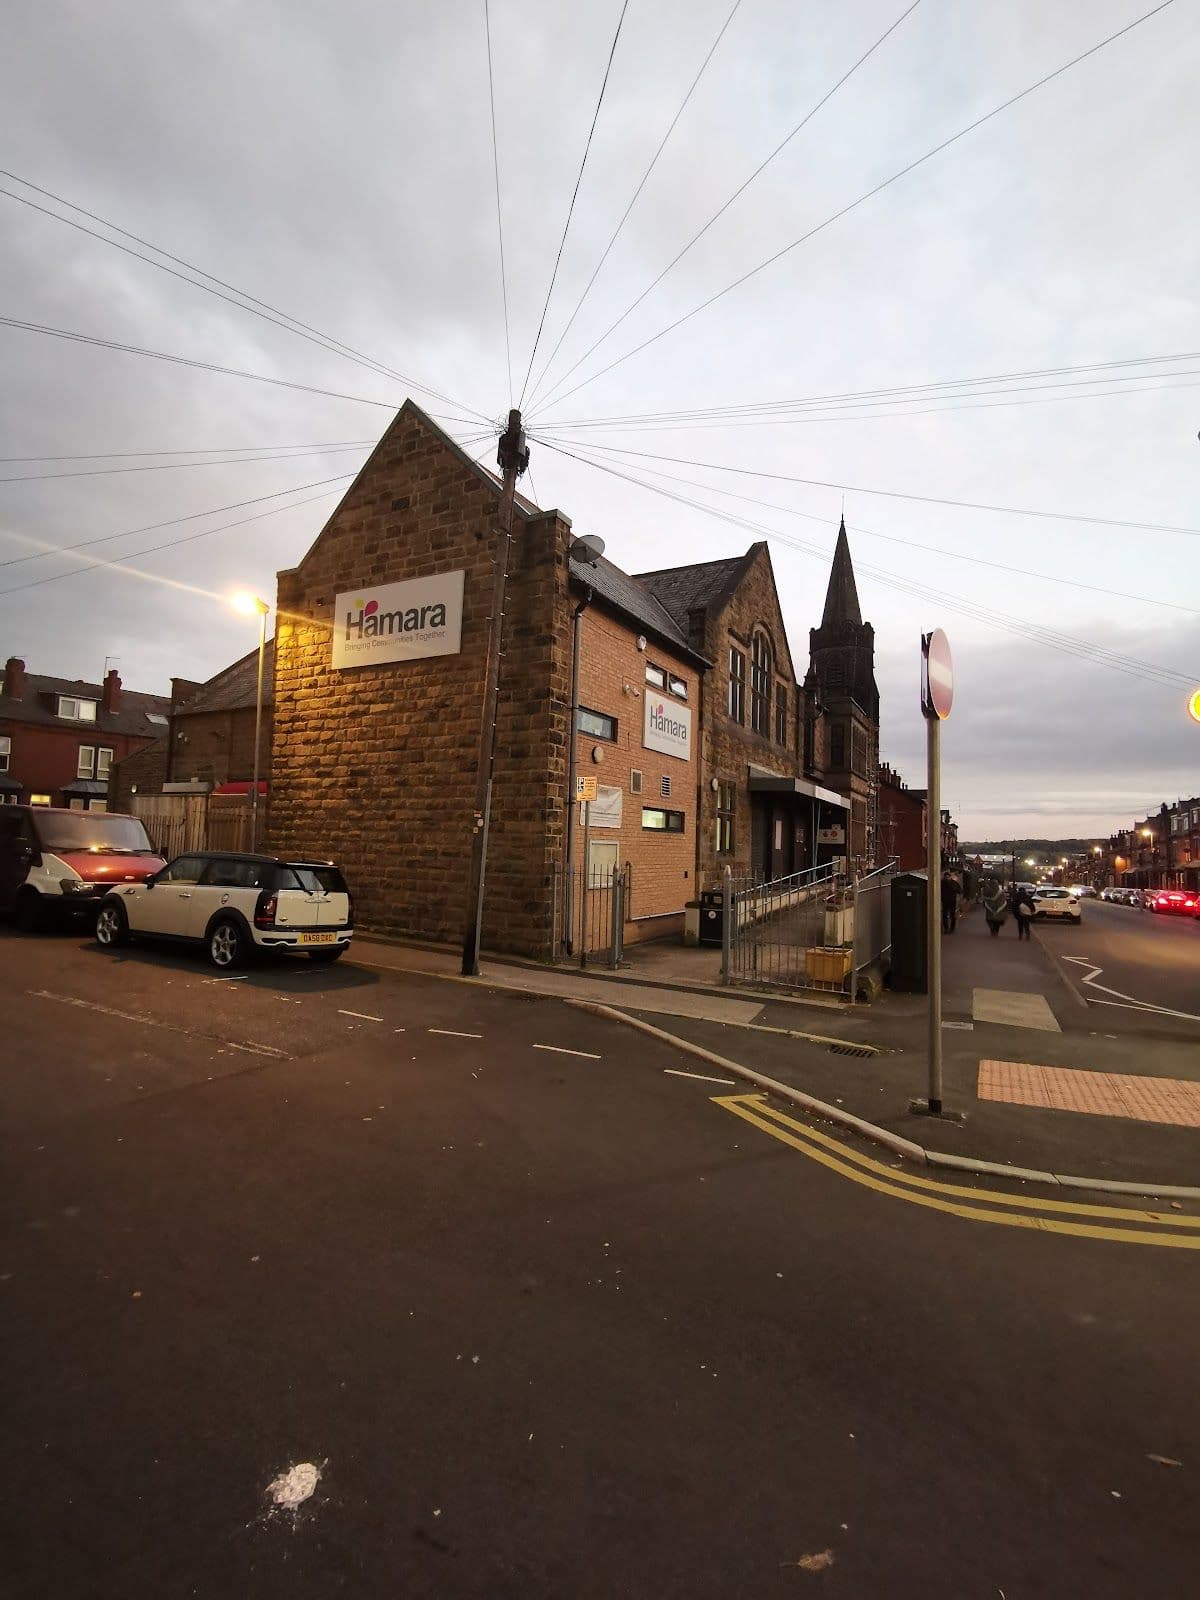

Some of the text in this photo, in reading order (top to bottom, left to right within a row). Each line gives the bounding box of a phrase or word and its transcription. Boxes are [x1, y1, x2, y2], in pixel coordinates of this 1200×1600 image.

[345, 603, 446, 641] Hamara
[344, 641, 371, 652] Bringing
[415, 630, 446, 643] Together
[650, 705, 687, 740] Hamara
